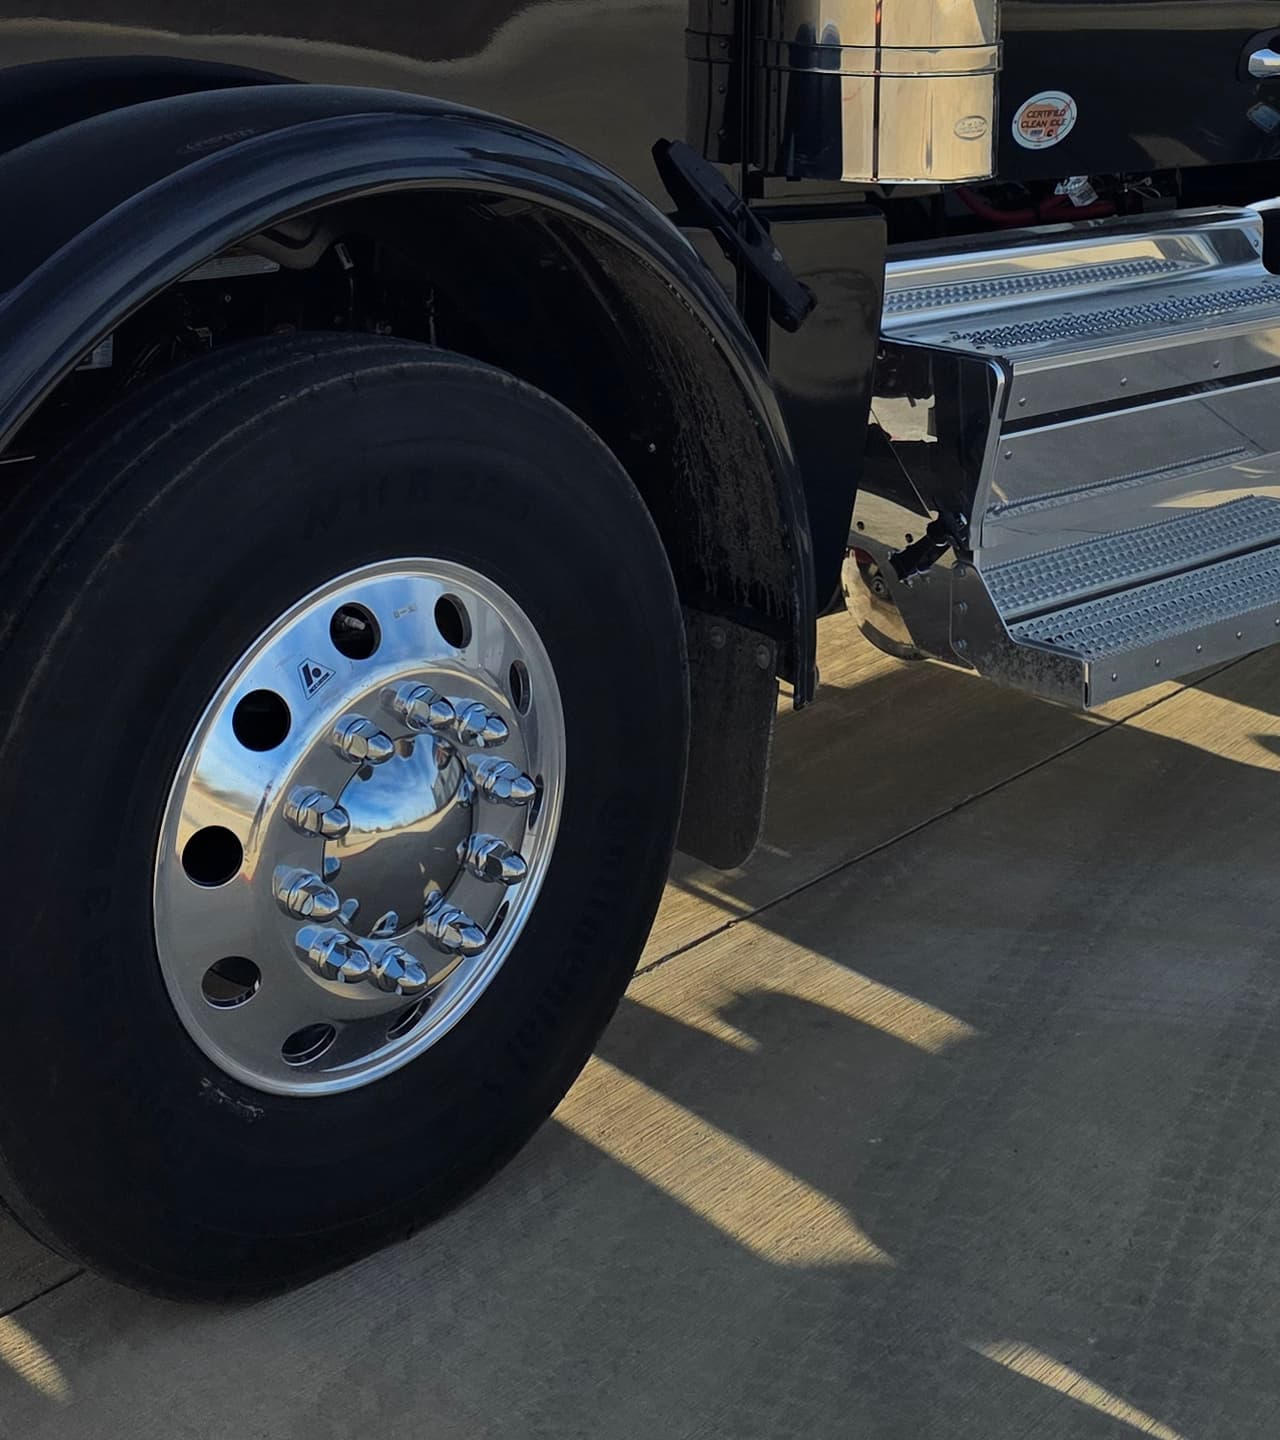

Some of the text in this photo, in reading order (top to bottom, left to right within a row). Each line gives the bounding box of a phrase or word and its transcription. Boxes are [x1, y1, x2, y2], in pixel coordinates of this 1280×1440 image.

[1026, 108, 1066, 119] CERTIFIED
[1021, 118, 1067, 129] CLEAN IDLE
